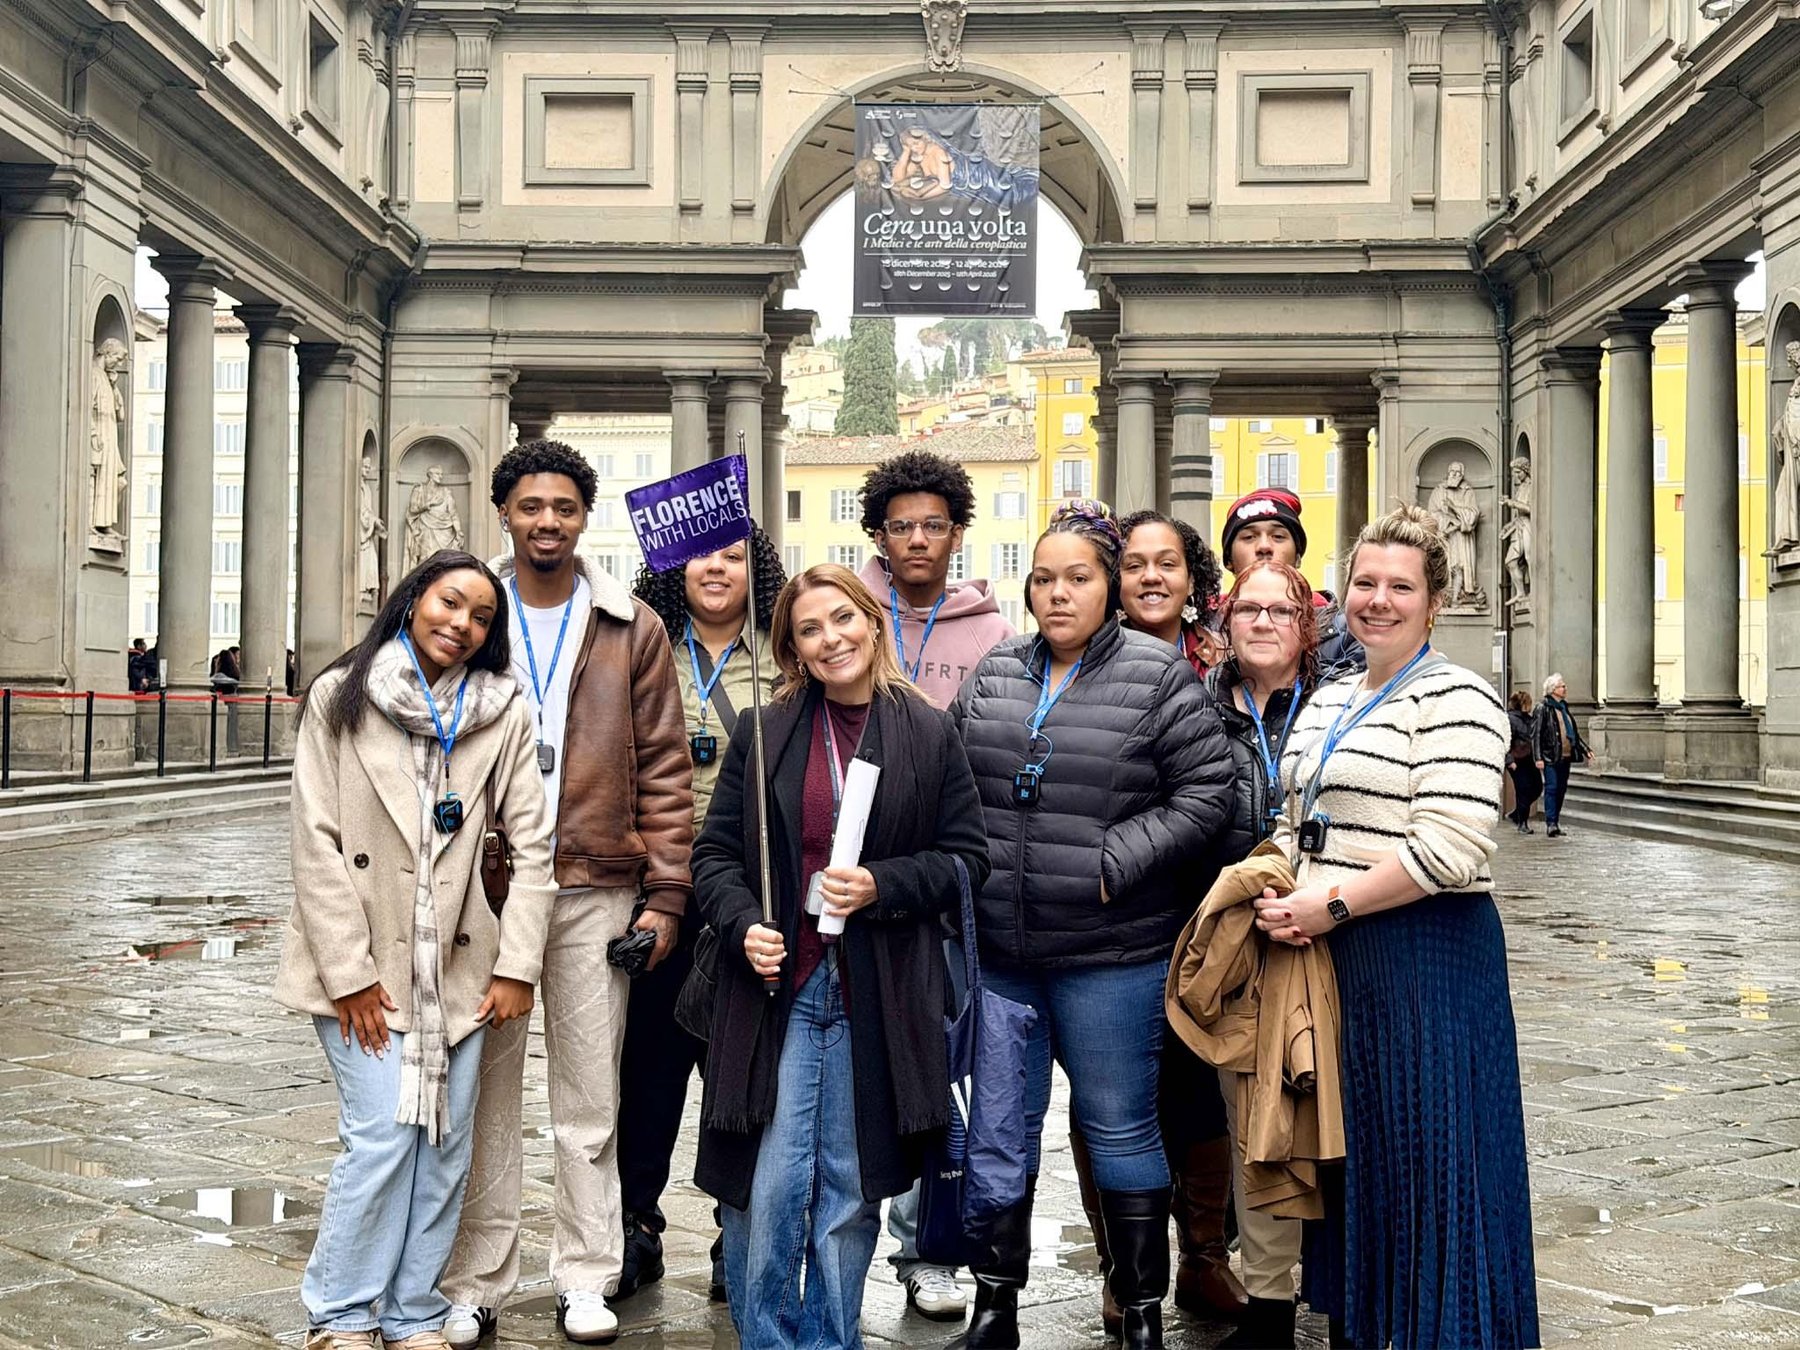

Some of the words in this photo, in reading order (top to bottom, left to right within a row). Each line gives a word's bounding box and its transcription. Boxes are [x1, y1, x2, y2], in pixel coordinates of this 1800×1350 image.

[864, 212, 914, 236] Cera
[921, 219, 964, 236] una
[969, 214, 1027, 236] volta
[863, 238, 868, 248] I
[871, 238, 905, 249] Medici
[906, 241, 913, 249] e
[914, 239, 923, 249] le
[924, 239, 942, 249] arti
[944, 238, 968, 249] della
[970, 238, 1027, 252] ceroplastica
[906, 270, 936, 278] December
[969, 270, 982, 278] April
[955, 260, 964, 268] 12
[964, 260, 988, 270] aple
[631, 475, 741, 535] FLORENCE
[640, 523, 686, 552] WITH
[687, 500, 747, 537] LOCALS
